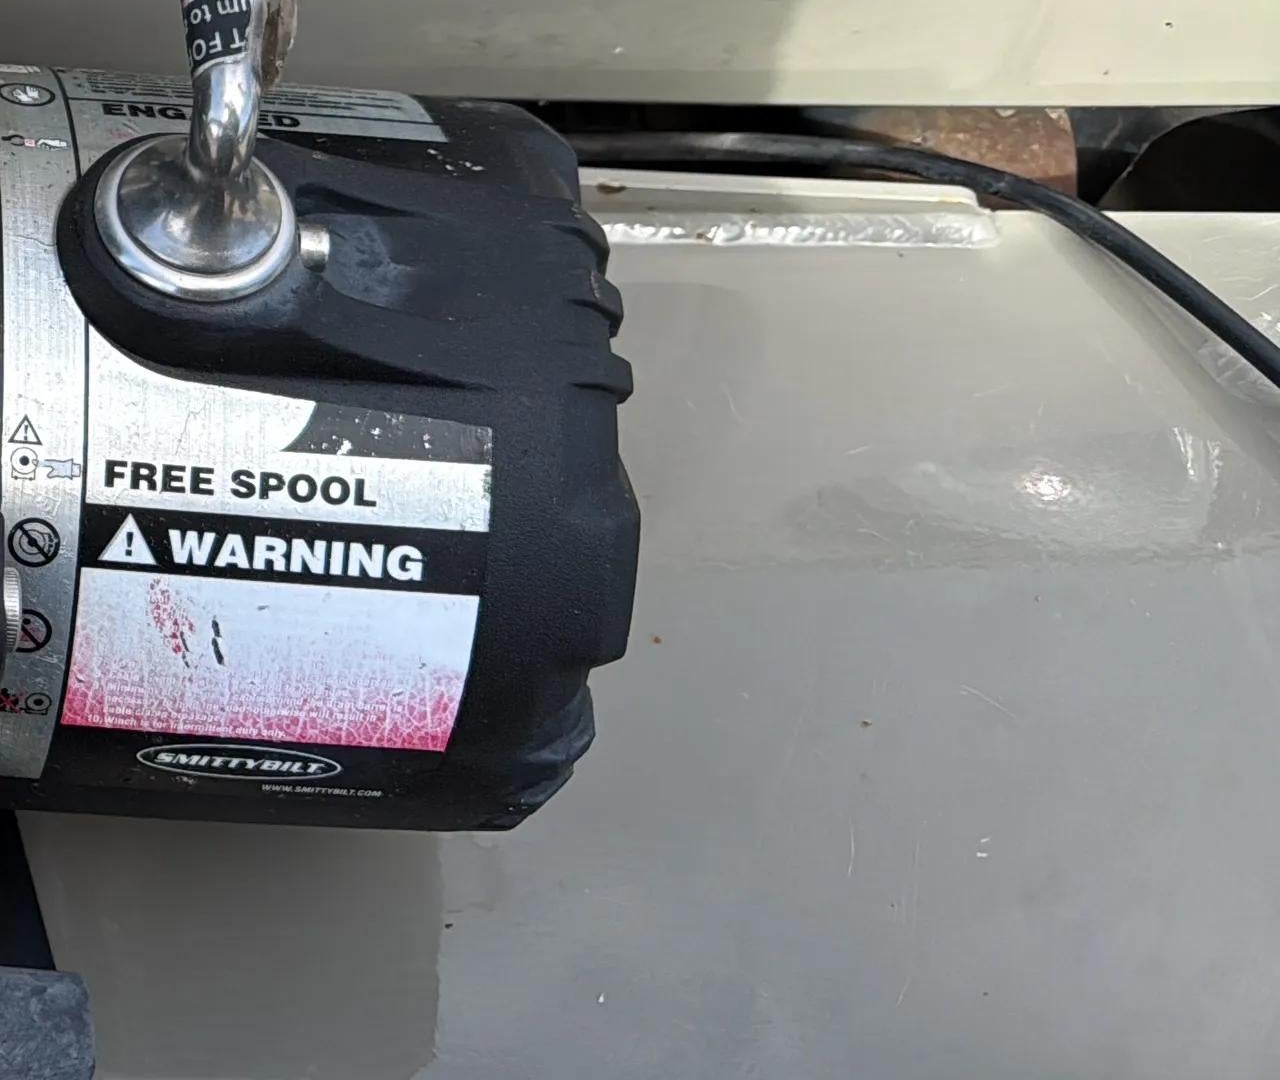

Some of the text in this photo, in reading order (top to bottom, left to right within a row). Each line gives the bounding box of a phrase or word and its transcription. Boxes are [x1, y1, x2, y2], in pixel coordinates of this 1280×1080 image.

[101, 103, 301, 129] ENGED
[104, 459, 378, 508] FREE SPOOL
[168, 528, 425, 582] WARNING
[154, 751, 326, 775] SMITTYBILT
[261, 782, 383, 799] WWW.SMITTYBILT.COM
